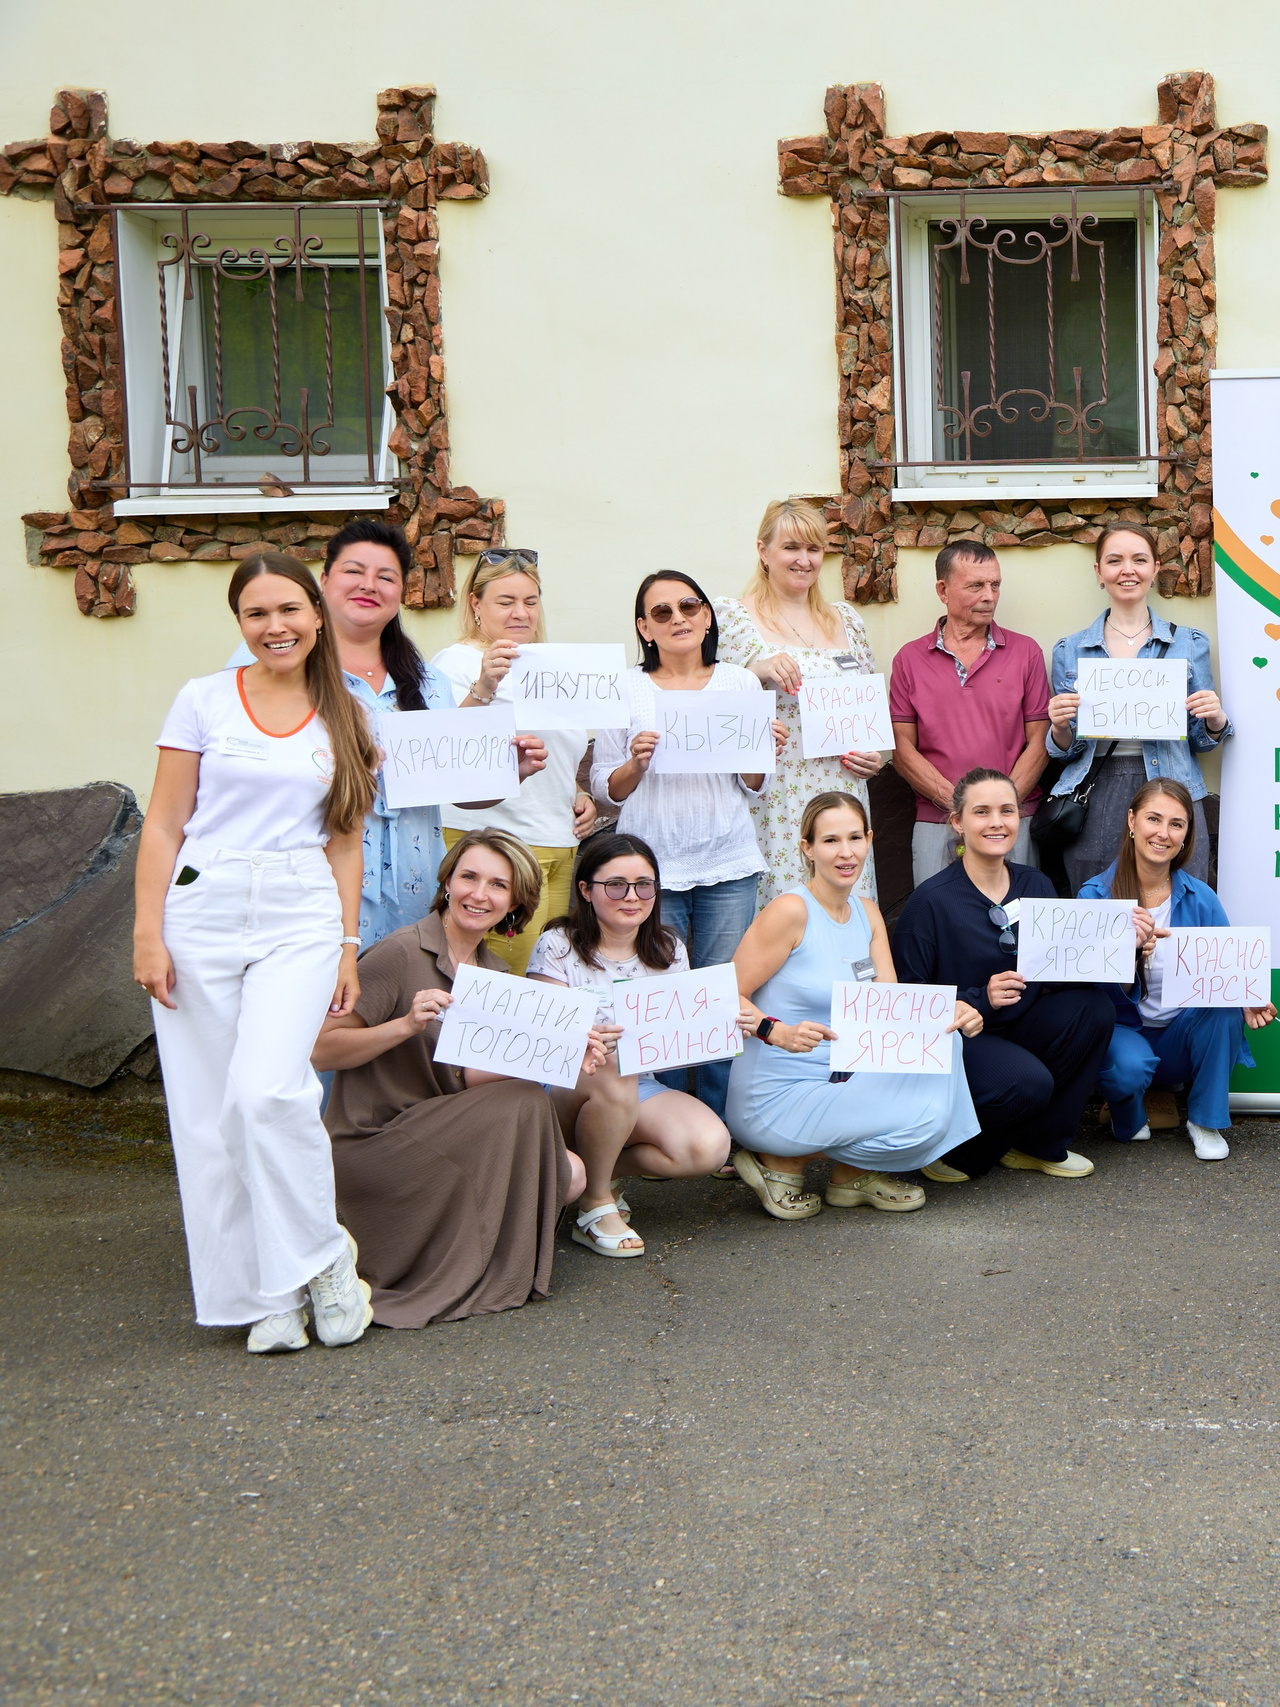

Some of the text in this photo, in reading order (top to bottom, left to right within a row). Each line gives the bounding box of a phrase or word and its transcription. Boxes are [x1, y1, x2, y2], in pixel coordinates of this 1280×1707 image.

[519, 669, 621, 701] ИРКУТСК
[804, 684, 881, 712] КРАСНО-
[1084, 668, 1170, 692] ЛЕСОСИ-
[664, 710, 774, 753] КЫЗЫЛ
[820, 711, 885, 749] ЯРСК
[1091, 701, 1179, 730] БИРСК
[389, 733, 517, 778] КРАСНОЯРСК
[1031, 904, 1133, 941] КРАСНО-
[1032, 945, 1122, 981] ЯРСК
[1175, 934, 1269, 977] КРАСНО-
[459, 979, 580, 1032] МАГНИ-
[625, 986, 721, 1026] ЧЕЛЯ-
[842, 986, 949, 1024] КРАСНО-
[1177, 974, 1262, 1007] ЯРСК
[457, 1021, 579, 1078] ТОГОРСК
[637, 1021, 739, 1066] БИНСК
[845, 1029, 945, 1070] ЯРСК
